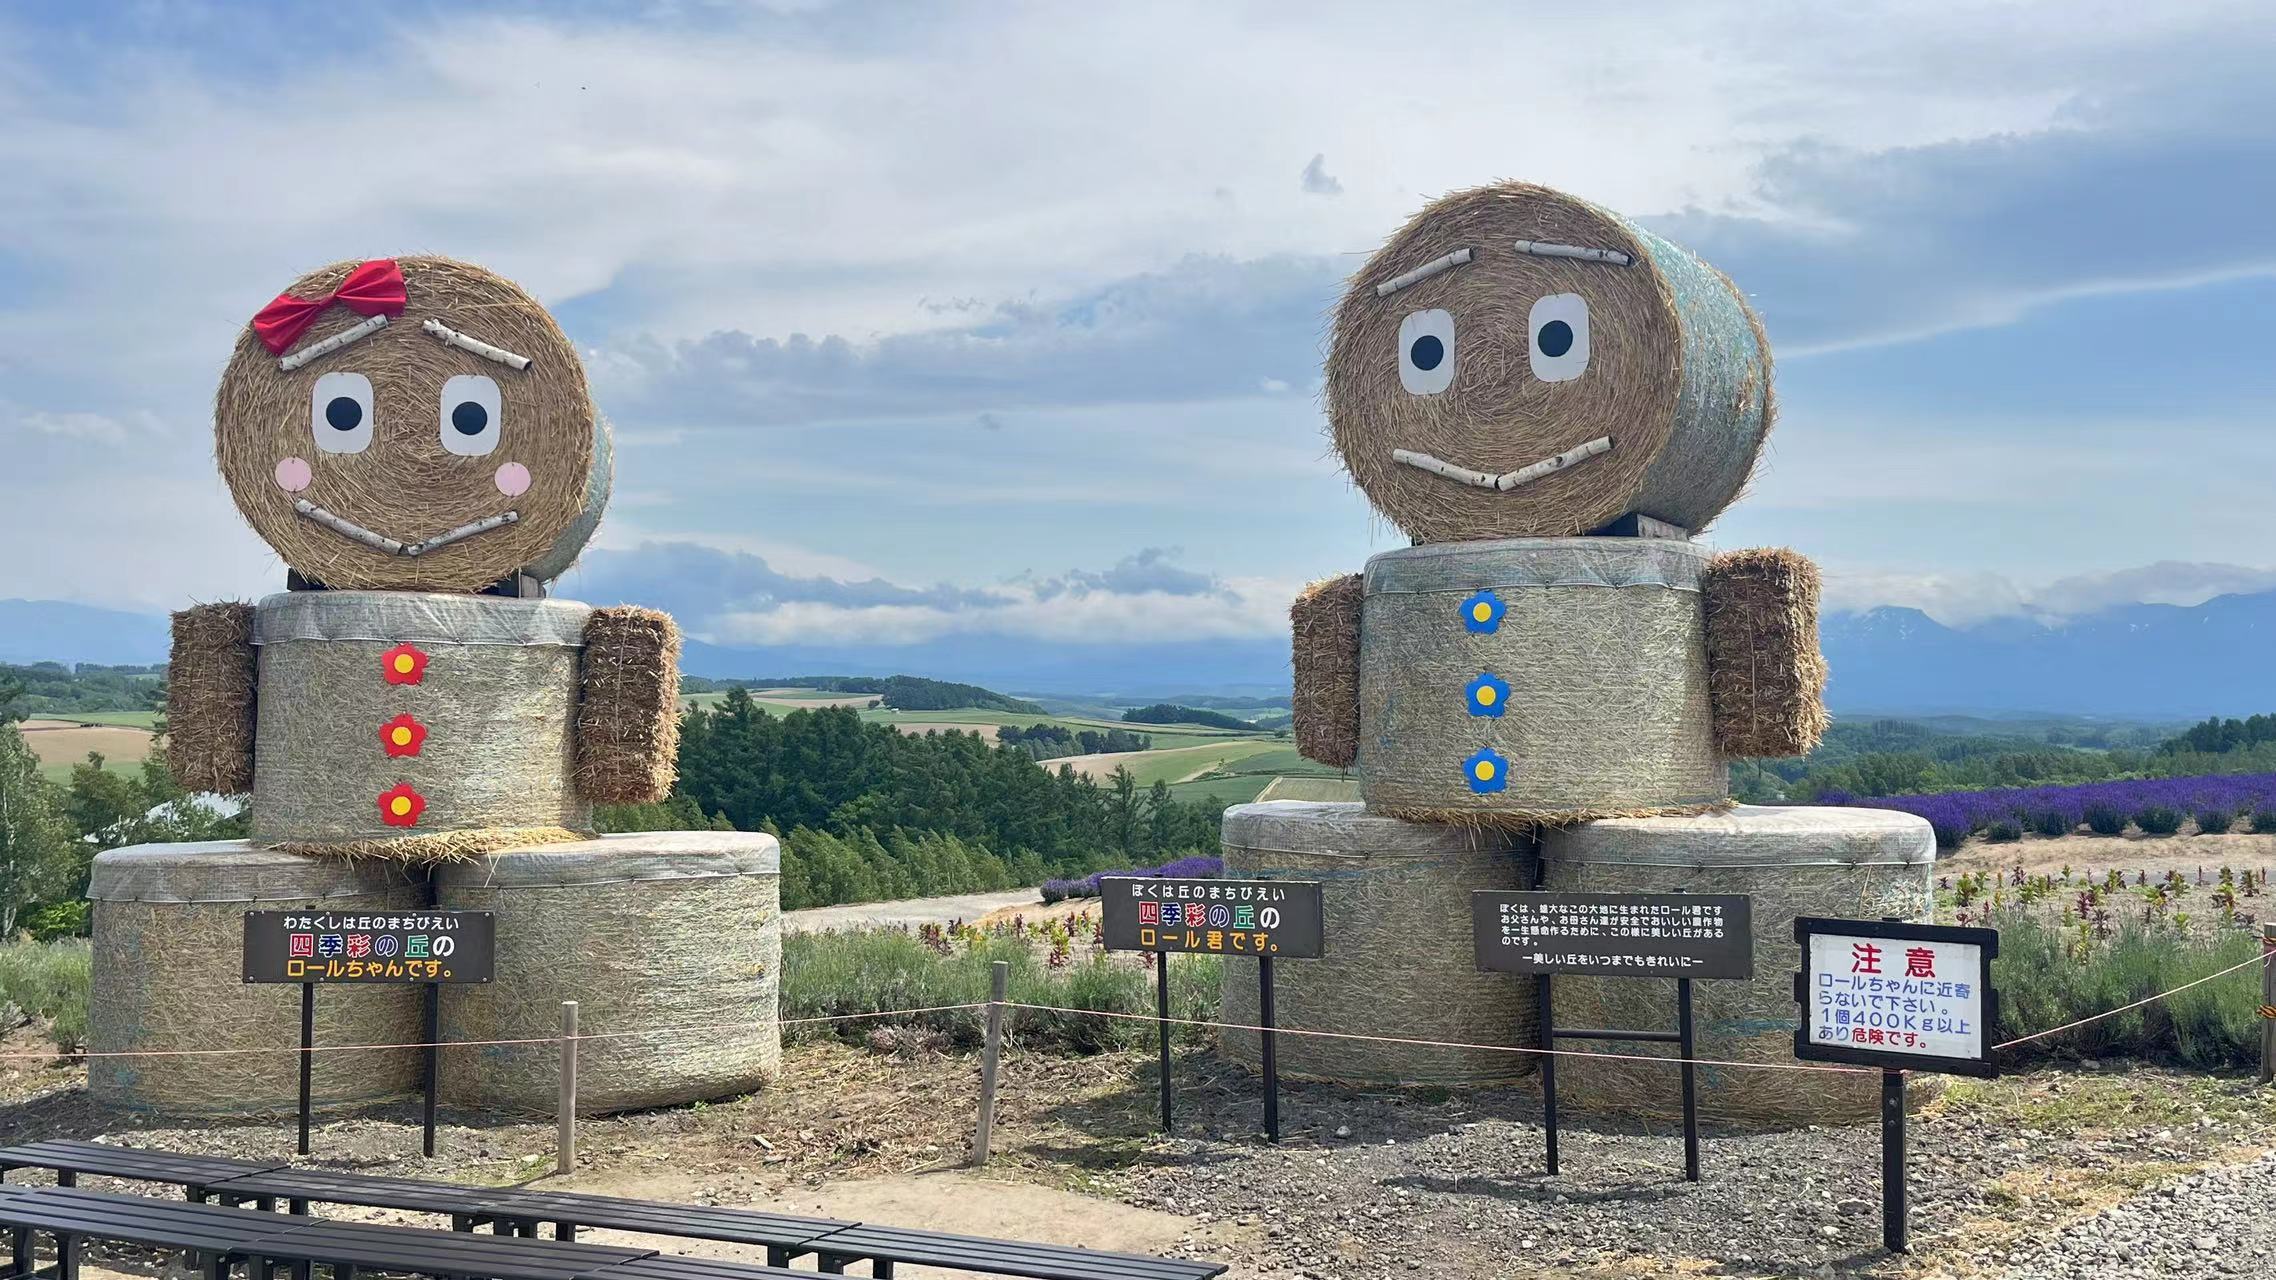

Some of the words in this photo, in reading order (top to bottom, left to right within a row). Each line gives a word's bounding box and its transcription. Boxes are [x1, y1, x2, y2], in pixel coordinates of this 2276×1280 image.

[1132, 884, 1285, 901] ぼくは丘のまちびえい
[284, 916, 459, 930] わたくしは丘のまちびえい
[1138, 901, 1280, 929] 四季彩の丘の
[289, 933, 455, 958] 四季彩の丘の
[1140, 929, 1278, 952] ロール君です。
[1501, 936, 1539, 946] のです。
[287, 960, 452, 977] ロールちゃんです。
[1818, 973, 1971, 999] ロールちゃんに近寄
[1818, 990, 1948, 1016] らないで下さい。
[1818, 1026, 1927, 1049] あり危険です。
